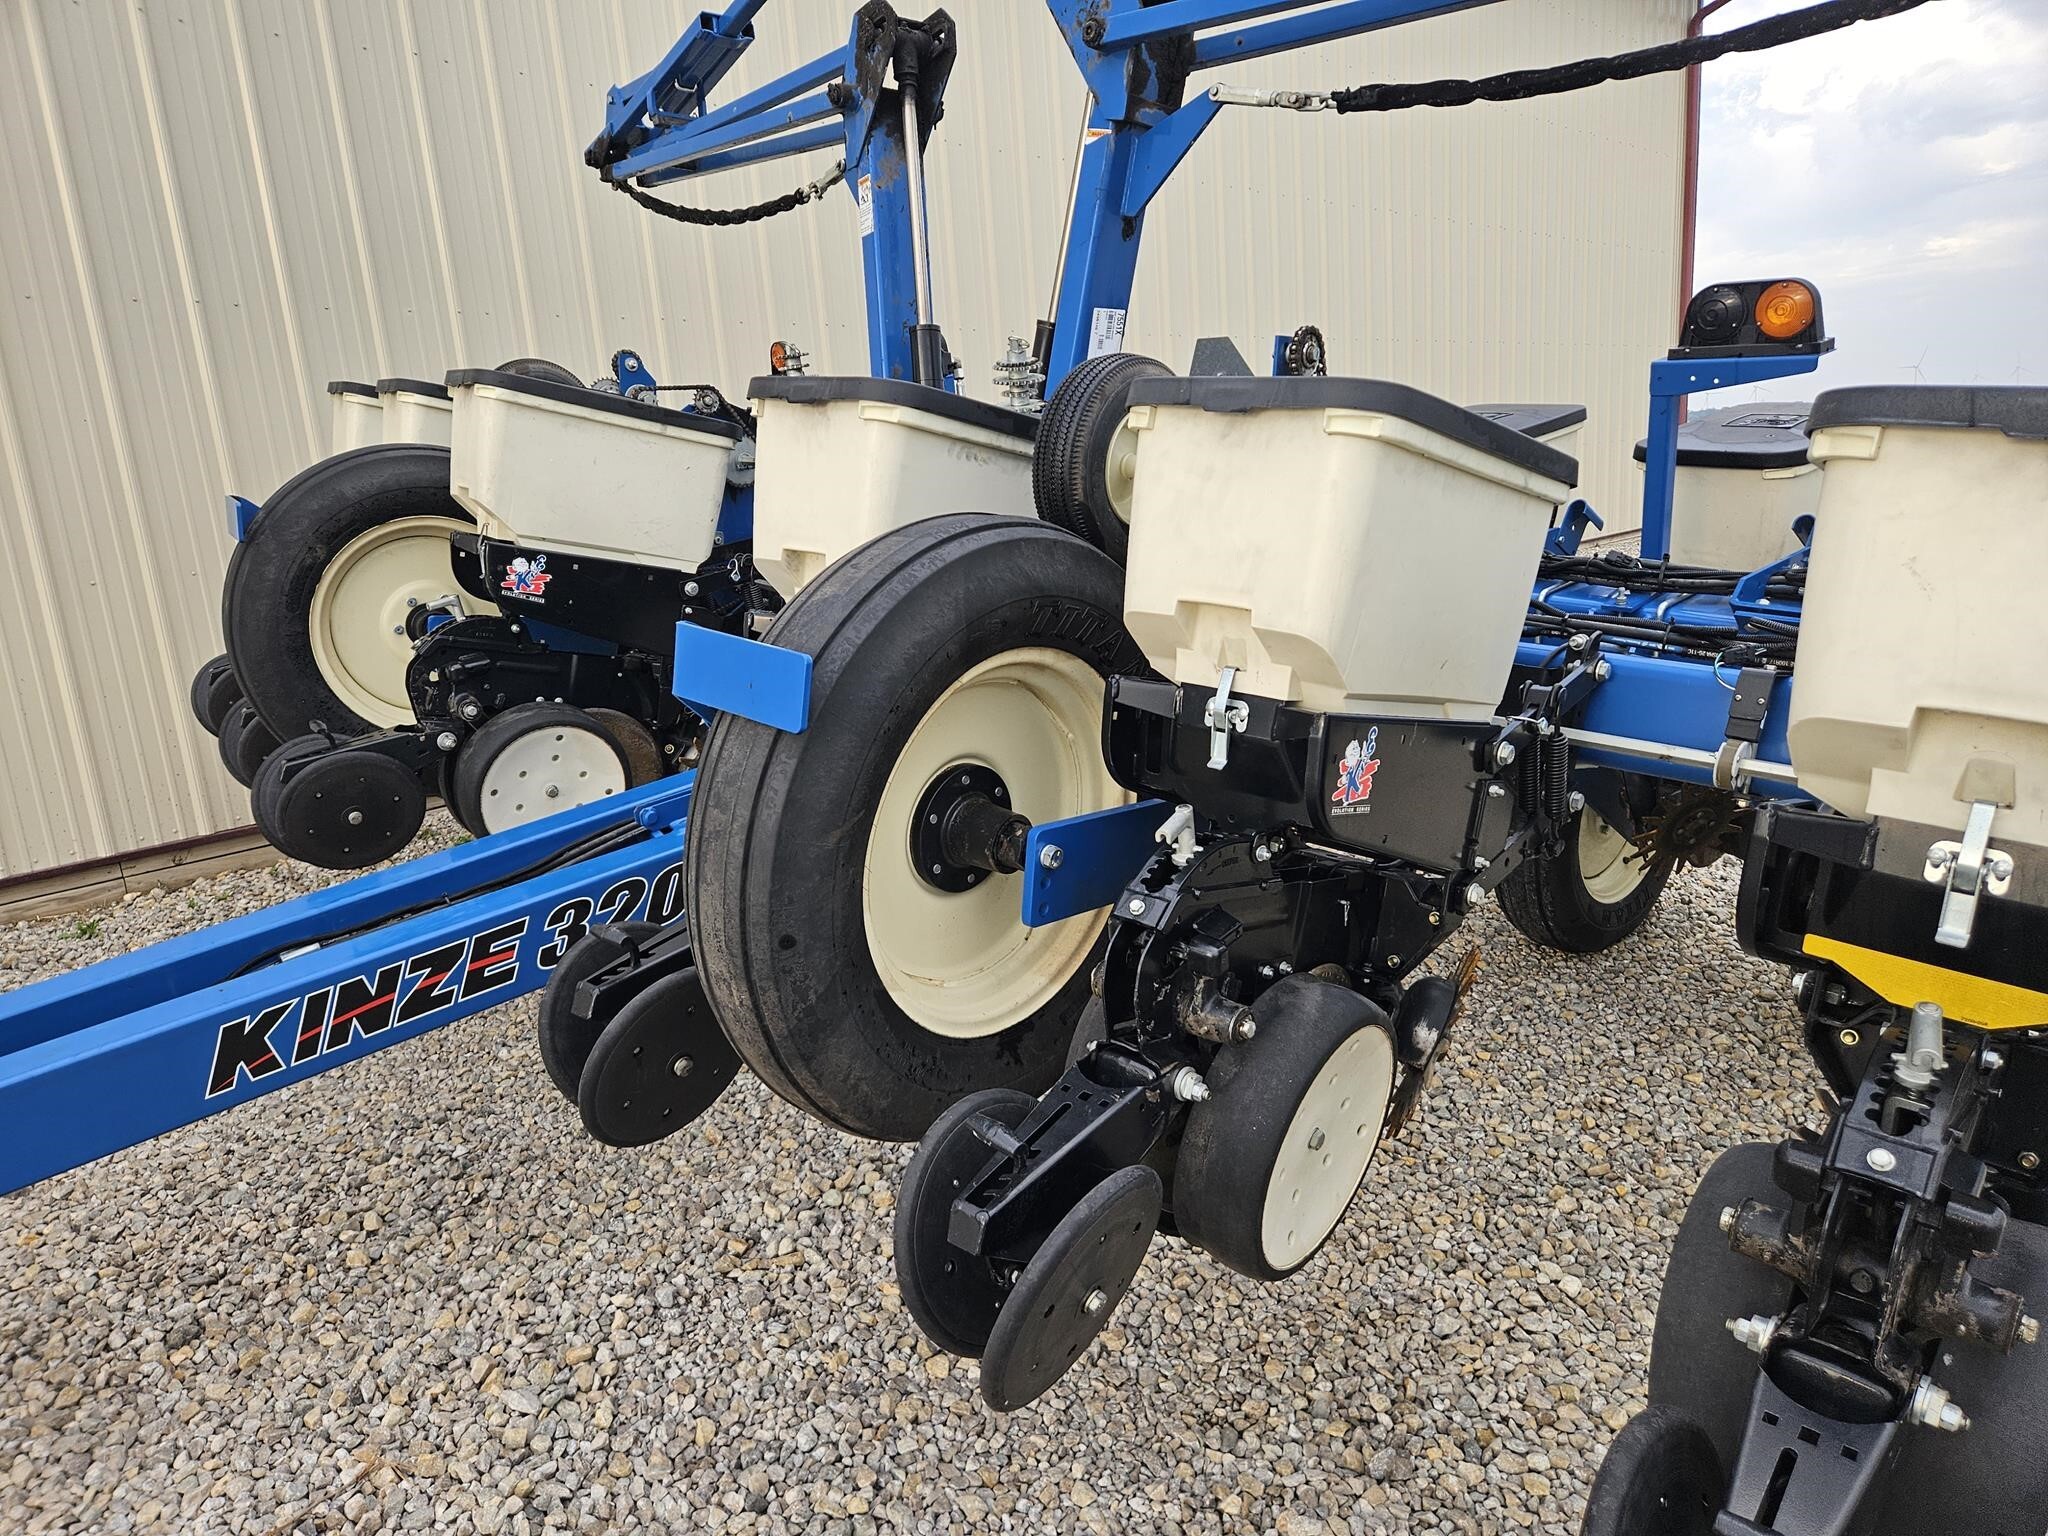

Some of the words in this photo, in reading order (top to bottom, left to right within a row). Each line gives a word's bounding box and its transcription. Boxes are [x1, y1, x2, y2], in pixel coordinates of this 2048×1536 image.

[1115, 312, 1124, 335] 7551X
[205, 916, 530, 1100] KINZE
[537, 861, 686, 970] 320
